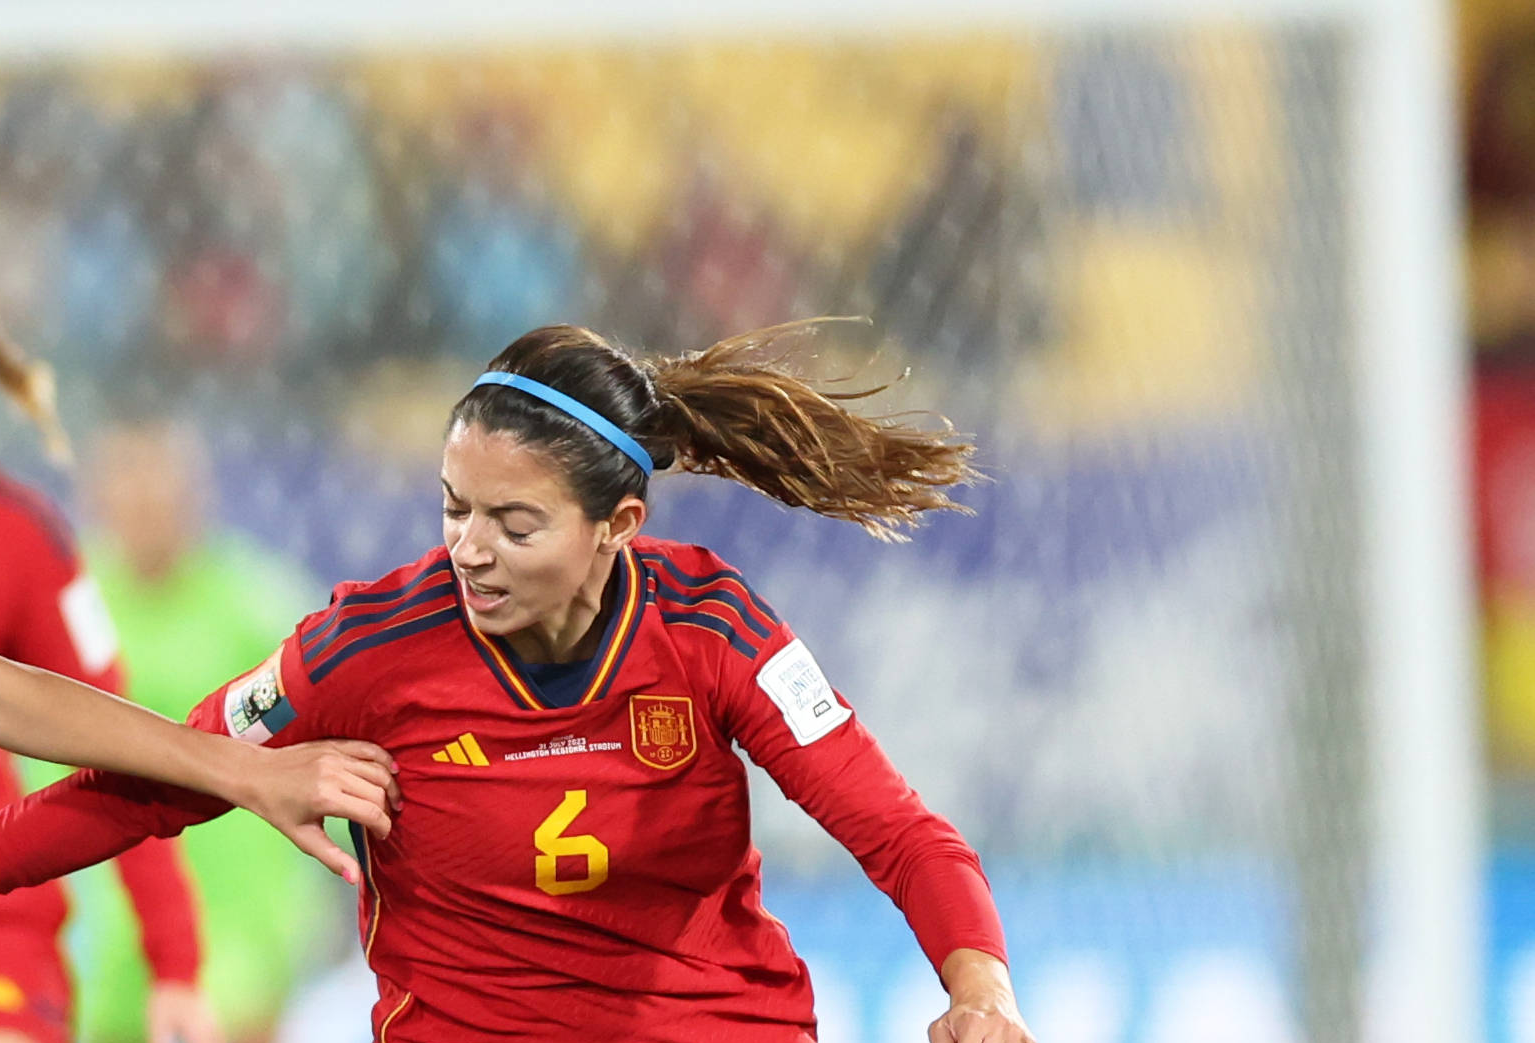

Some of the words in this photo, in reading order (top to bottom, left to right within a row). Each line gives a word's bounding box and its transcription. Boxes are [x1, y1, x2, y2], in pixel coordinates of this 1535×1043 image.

[504, 749, 550, 761] WELLINGTON
[551, 745, 587, 756] REGIONAL
[589, 742, 622, 752] STADIUM
[549, 741, 566, 749] JULY
[567, 737, 586, 746] 2023
[534, 790, 609, 896] 6
